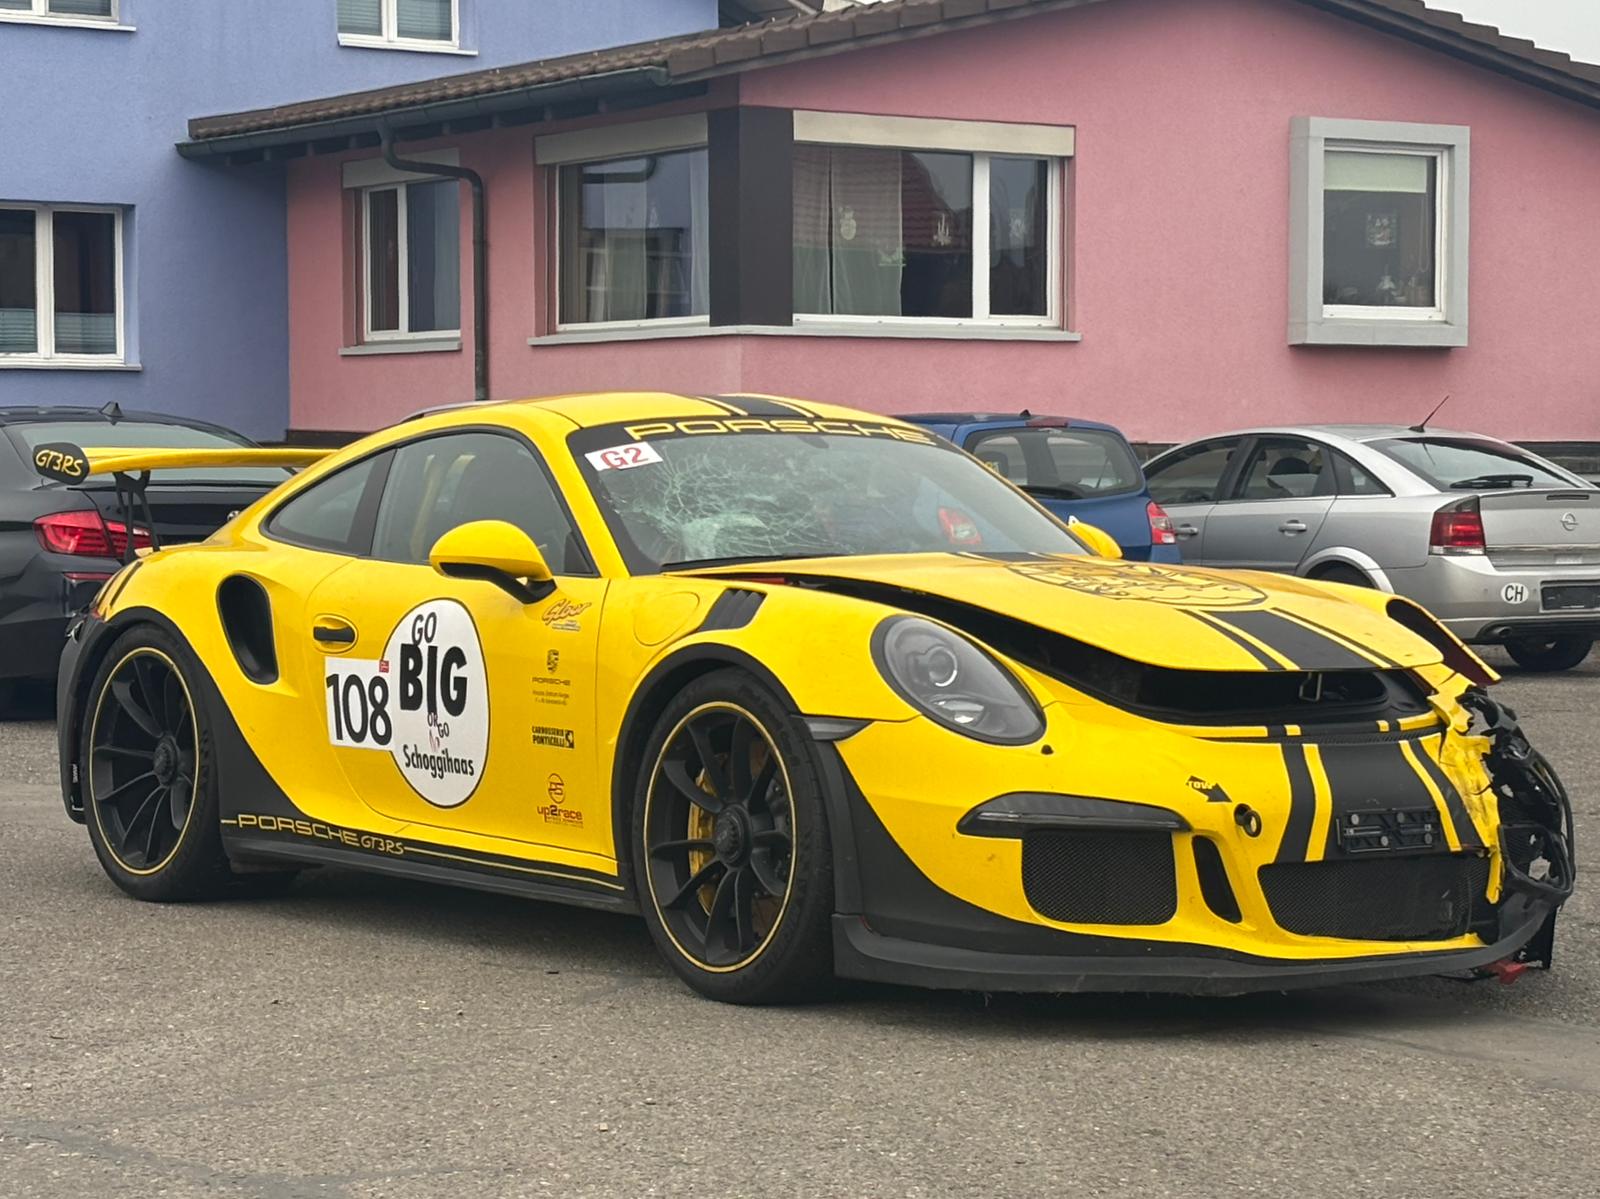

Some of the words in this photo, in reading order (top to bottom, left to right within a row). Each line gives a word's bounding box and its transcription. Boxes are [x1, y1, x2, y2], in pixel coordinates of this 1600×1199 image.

[623, 419, 937, 447] PORSCHE
[35, 449, 83, 476] GT3RS
[600, 446, 649, 470] G2
[1504, 584, 1524, 602] CH
[411, 611, 437, 646] GO
[400, 643, 468, 717] BIG
[326, 673, 392, 746] 108
[427, 711, 438, 727] OR
[437, 722, 450, 738] GO
[403, 744, 475, 780] Schoggihaas
[537, 805, 584, 823] up2race
[237, 814, 360, 847] PORSCHE
[360, 835, 405, 855] GT3RS
